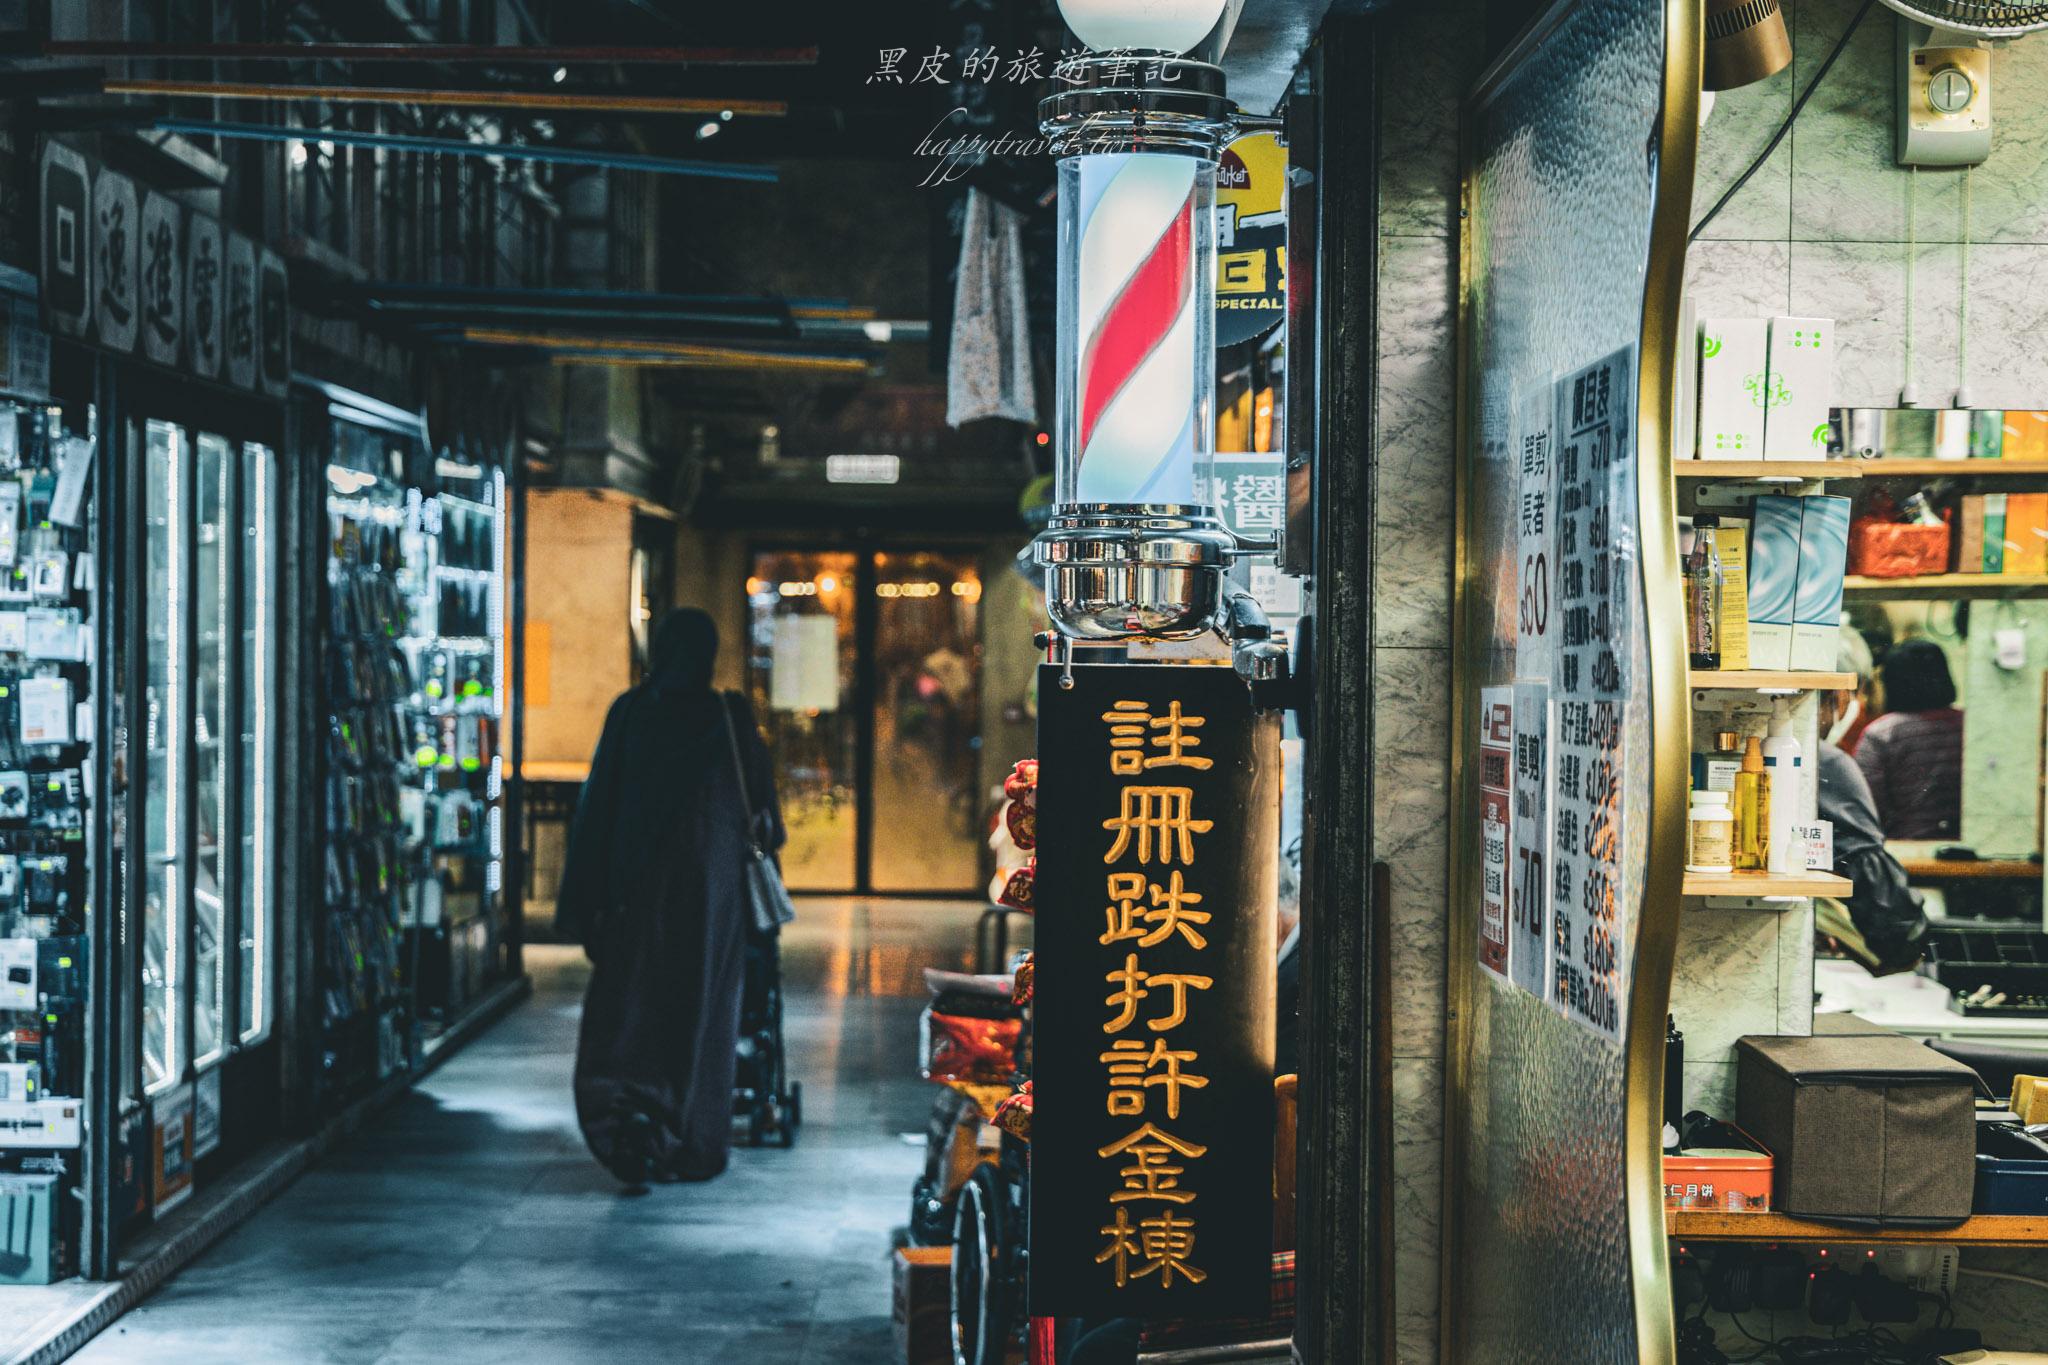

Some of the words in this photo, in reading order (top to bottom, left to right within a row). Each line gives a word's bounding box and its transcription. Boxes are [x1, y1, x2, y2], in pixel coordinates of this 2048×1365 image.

[1572, 365, 1612, 428] 價目表
[1523, 431, 1547, 478] 單剪
[1522, 489, 1546, 537] 長者
[1518, 732, 1540, 781] 單剪
[1095, 700, 1214, 1288] 註冊跌打許金棟
